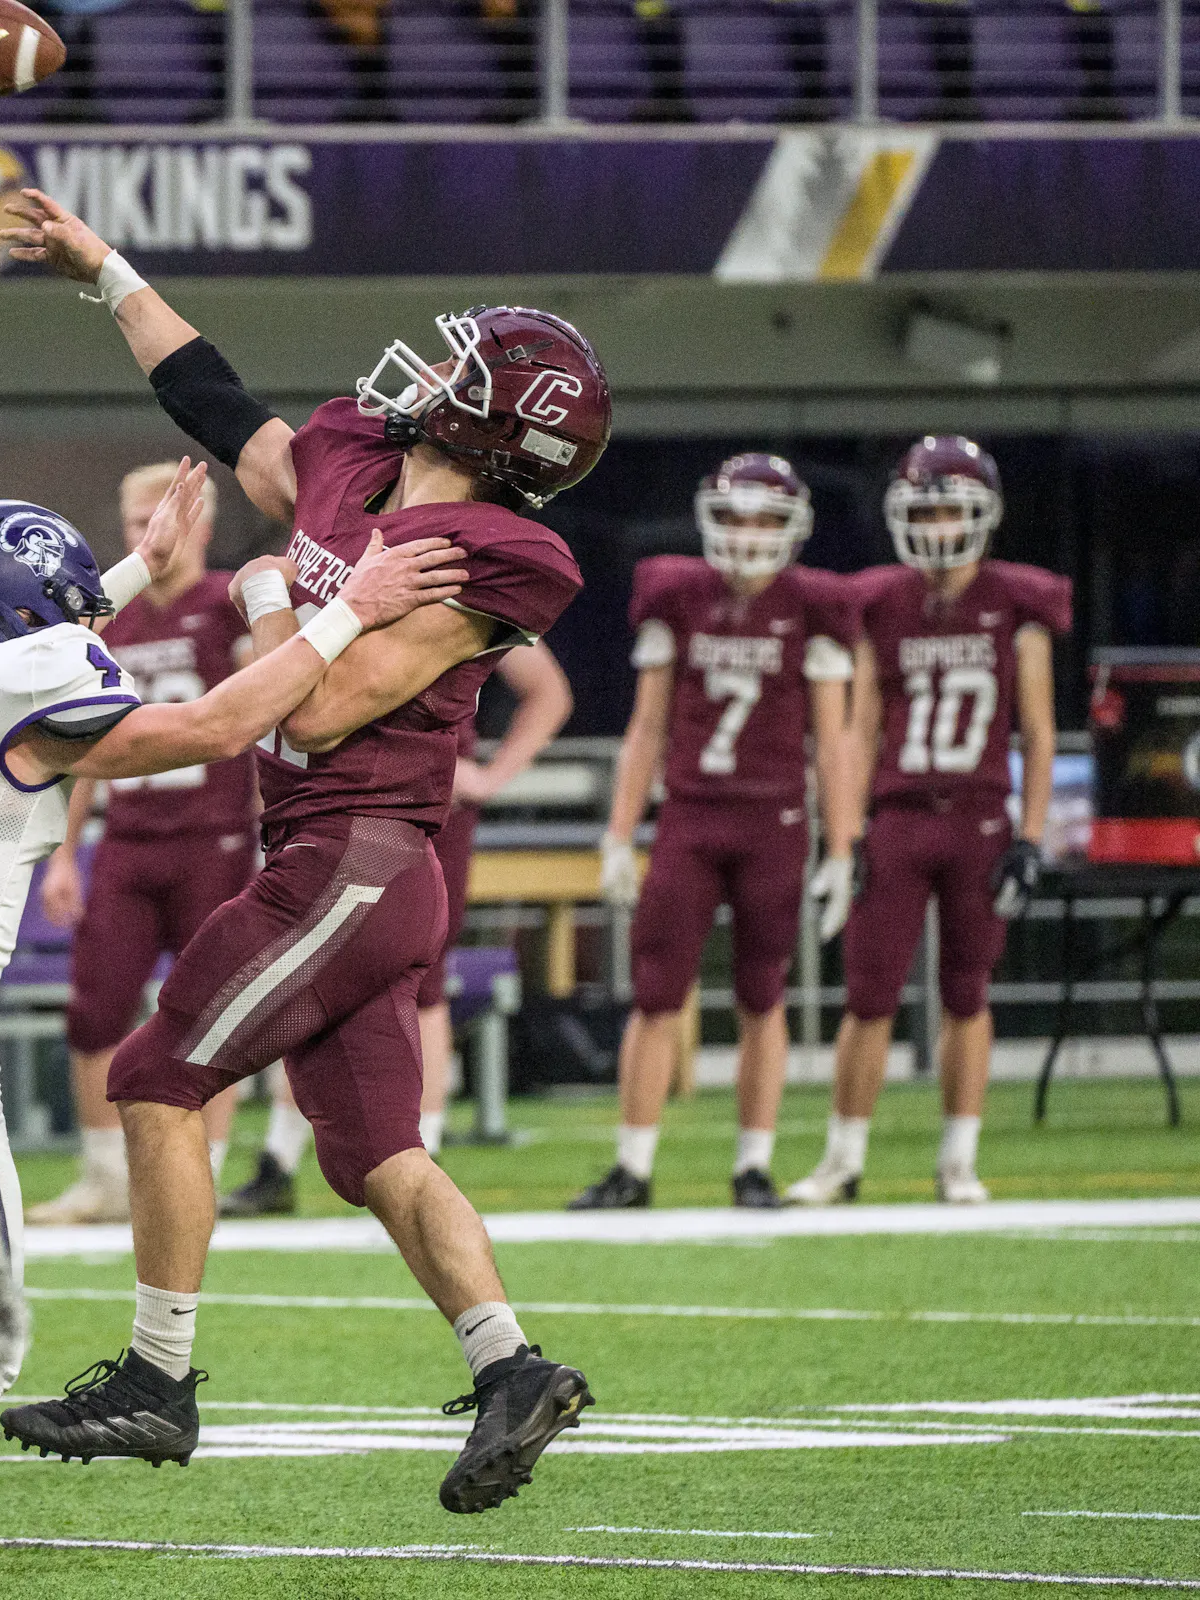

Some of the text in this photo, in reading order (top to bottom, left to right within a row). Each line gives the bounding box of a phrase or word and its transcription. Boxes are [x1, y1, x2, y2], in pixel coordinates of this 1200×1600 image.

[37, 146, 312, 249] VIKINGS
[515, 370, 583, 426] C
[86, 643, 121, 689] 4
[699, 672, 762, 775] 7
[898, 669, 998, 774] 10
